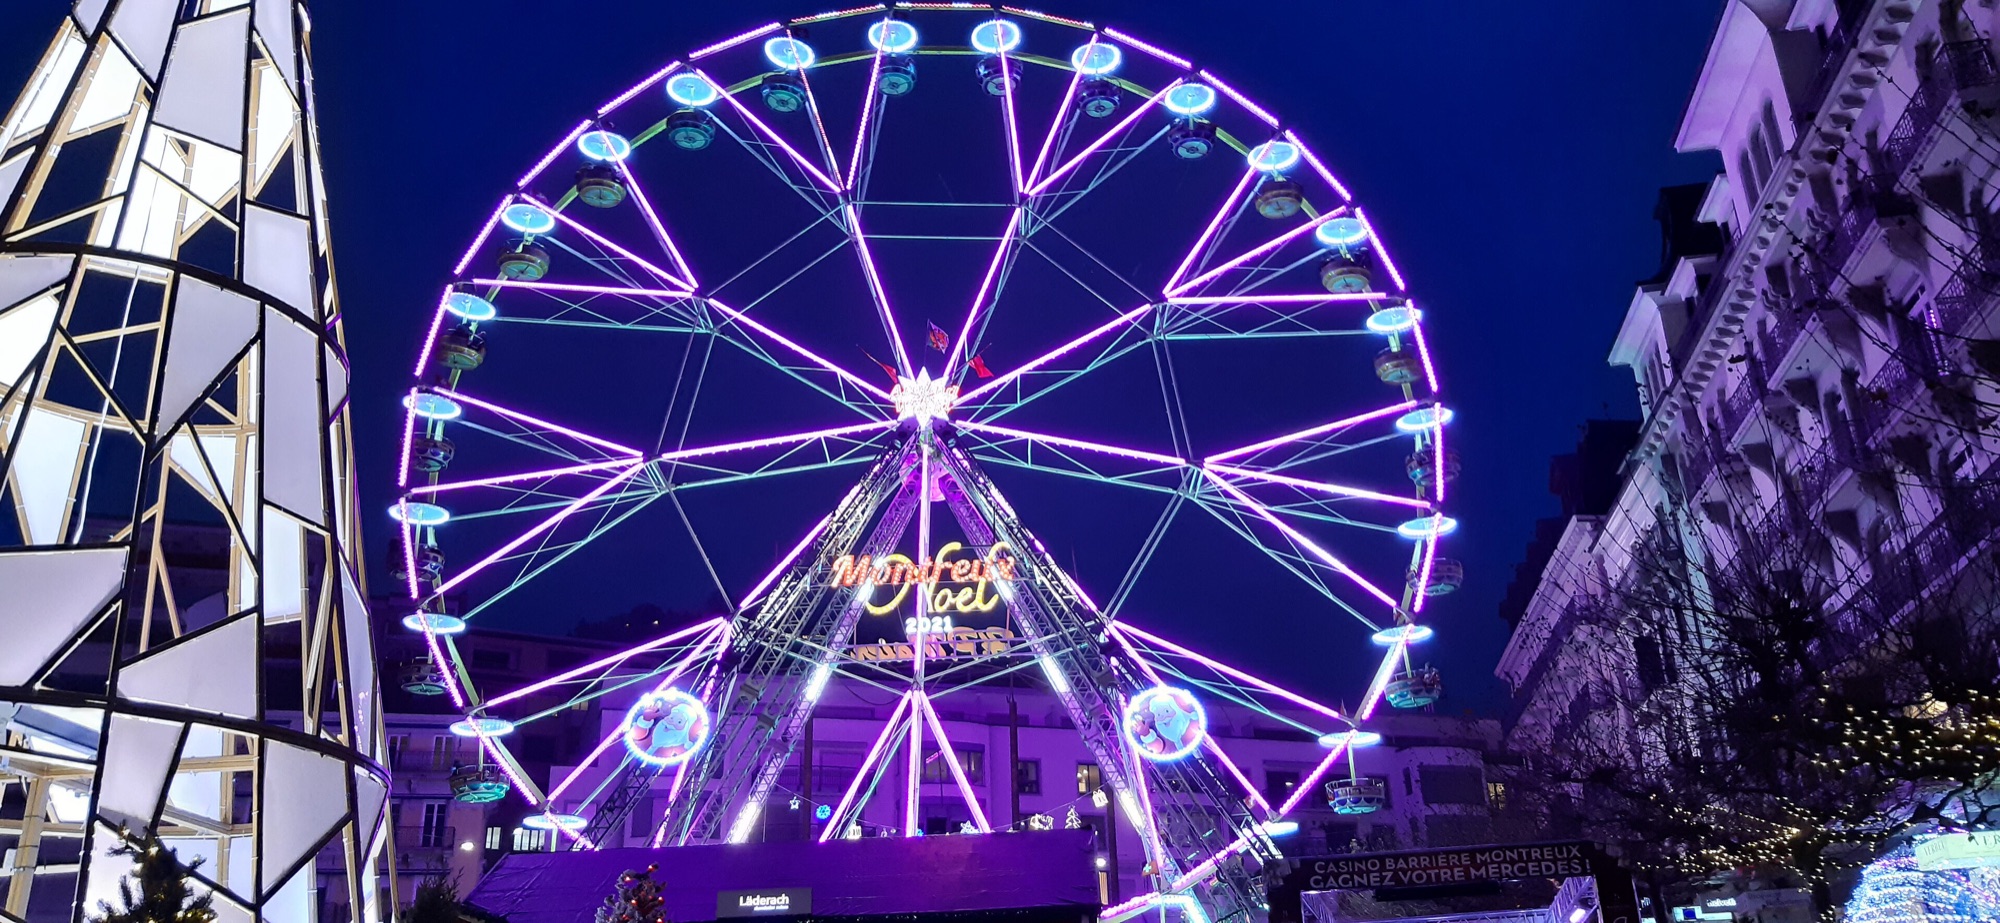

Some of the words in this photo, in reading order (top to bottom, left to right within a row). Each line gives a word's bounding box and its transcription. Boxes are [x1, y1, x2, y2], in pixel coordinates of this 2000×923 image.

[831, 554, 1015, 588] Montreux
[905, 615, 953, 633] 2021
[1309, 872, 1395, 889] GAGNEZ
[1398, 866, 1466, 885] VOTRE
[1471, 860, 1582, 879] MERCEDES
[1314, 858, 1380, 875] CASINO
[1385, 852, 1471, 870] BARRIÈRE
[1476, 845, 1581, 864] MONTREUX
[739, 893, 790, 907] Läderach
